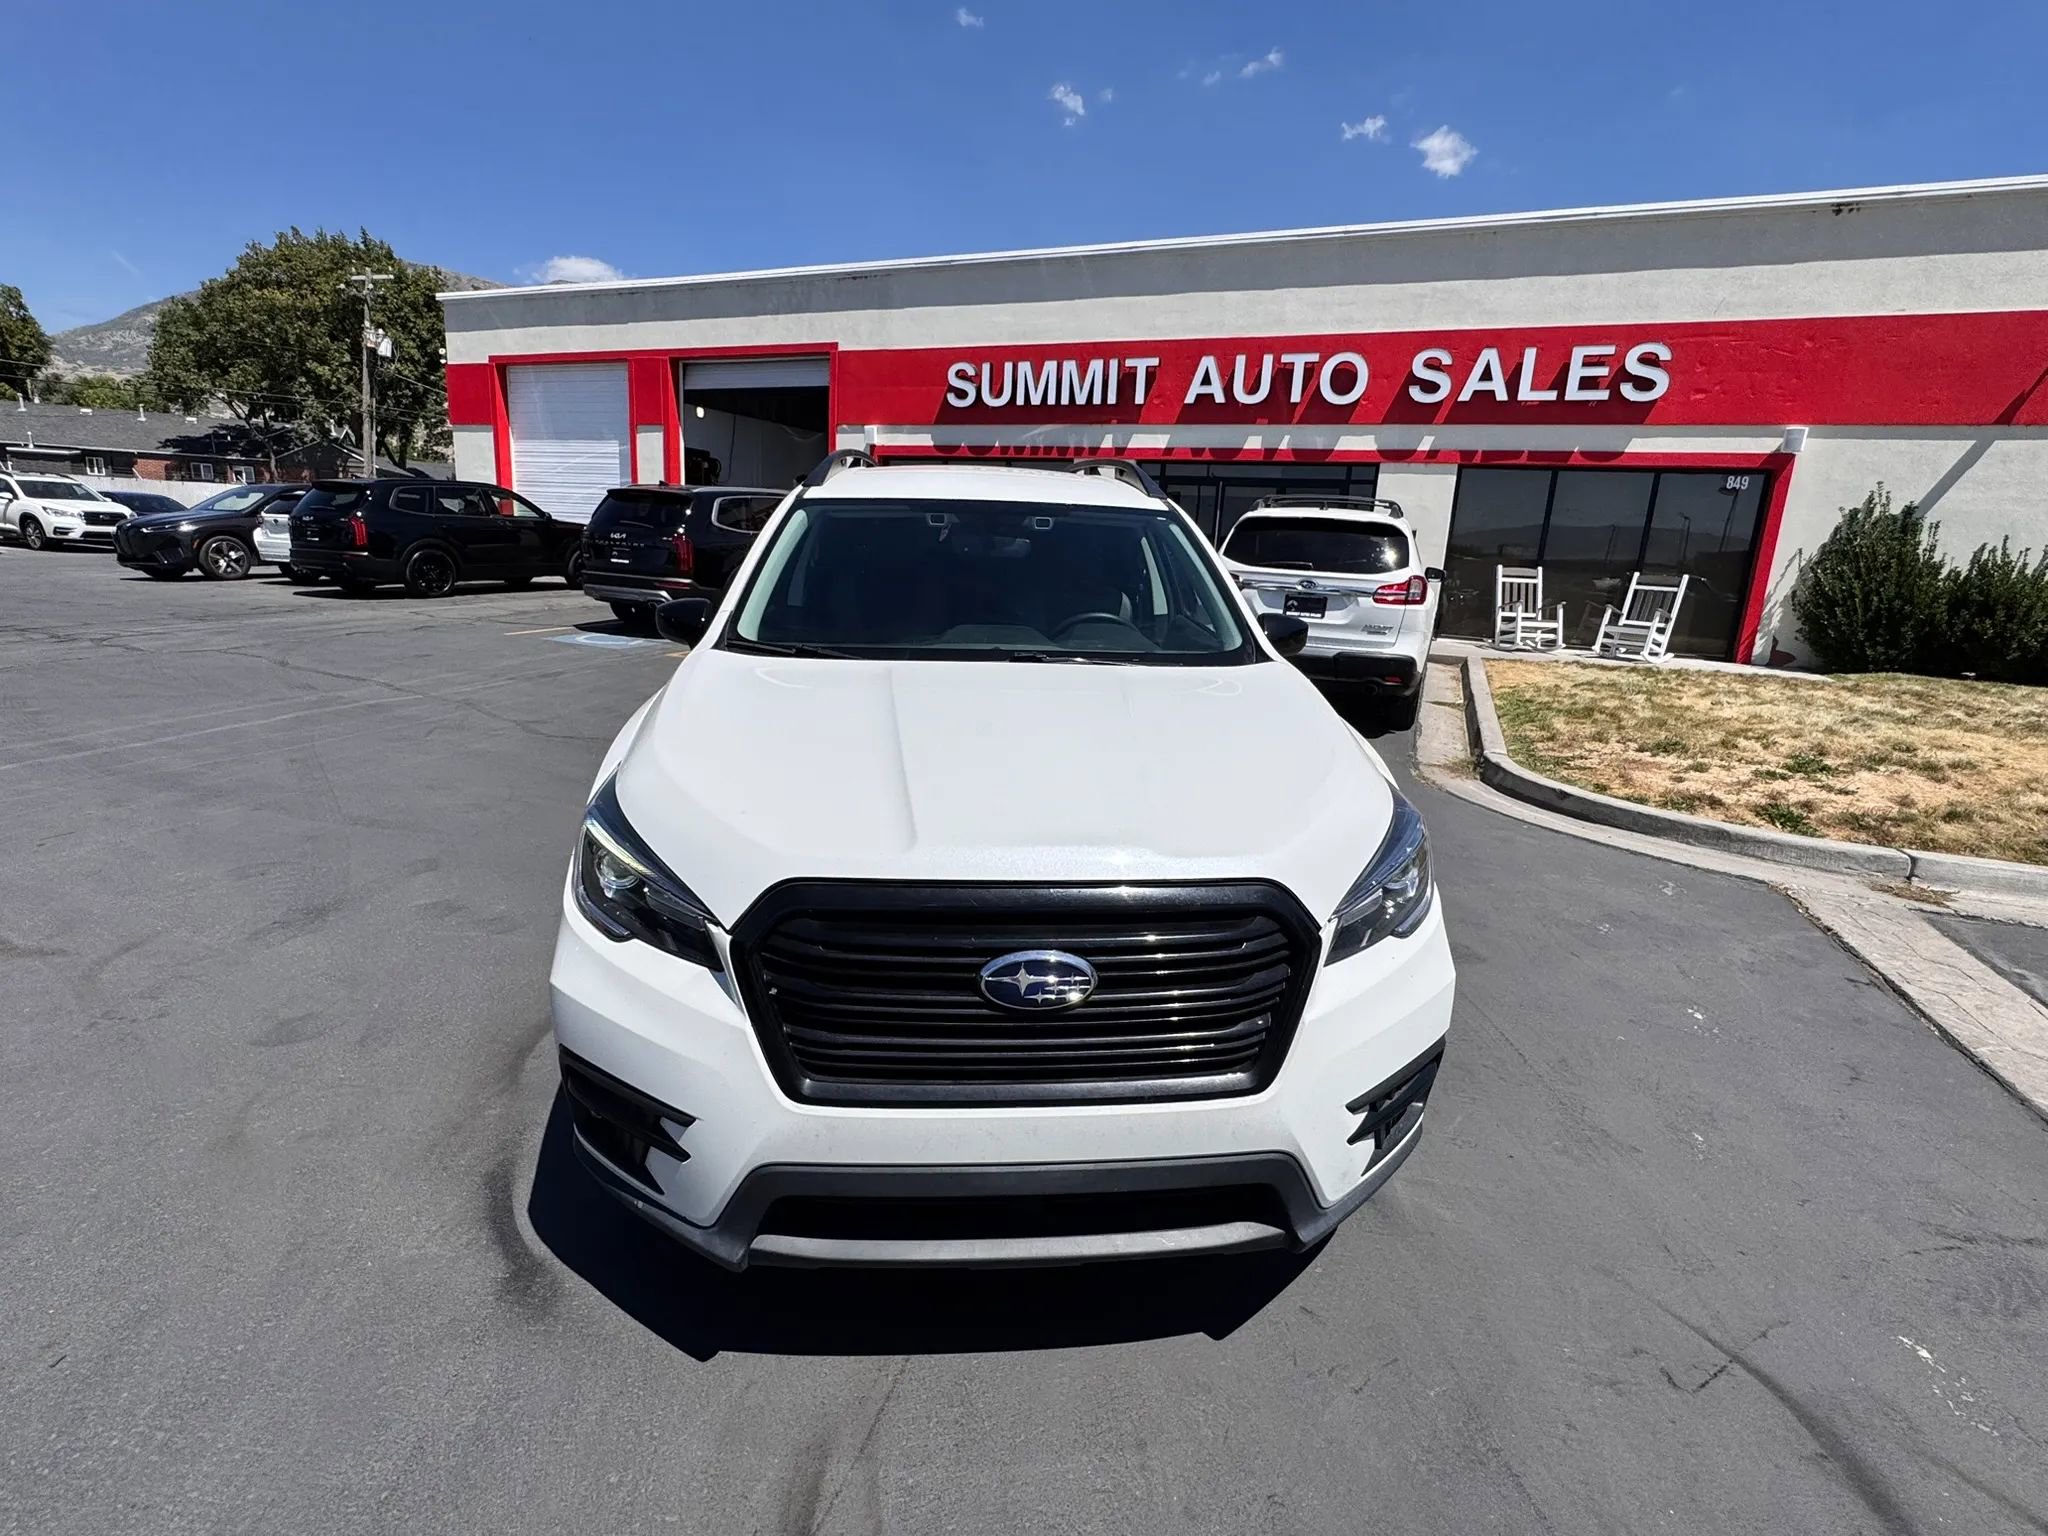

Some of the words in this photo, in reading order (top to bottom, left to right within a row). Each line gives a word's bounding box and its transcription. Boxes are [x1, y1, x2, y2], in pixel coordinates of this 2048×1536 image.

[946, 356, 1160, 408] SUMMIT
[1184, 352, 1370, 406] AUTO
[1408, 341, 1673, 404] SALES
[1726, 475, 1750, 490] 849
